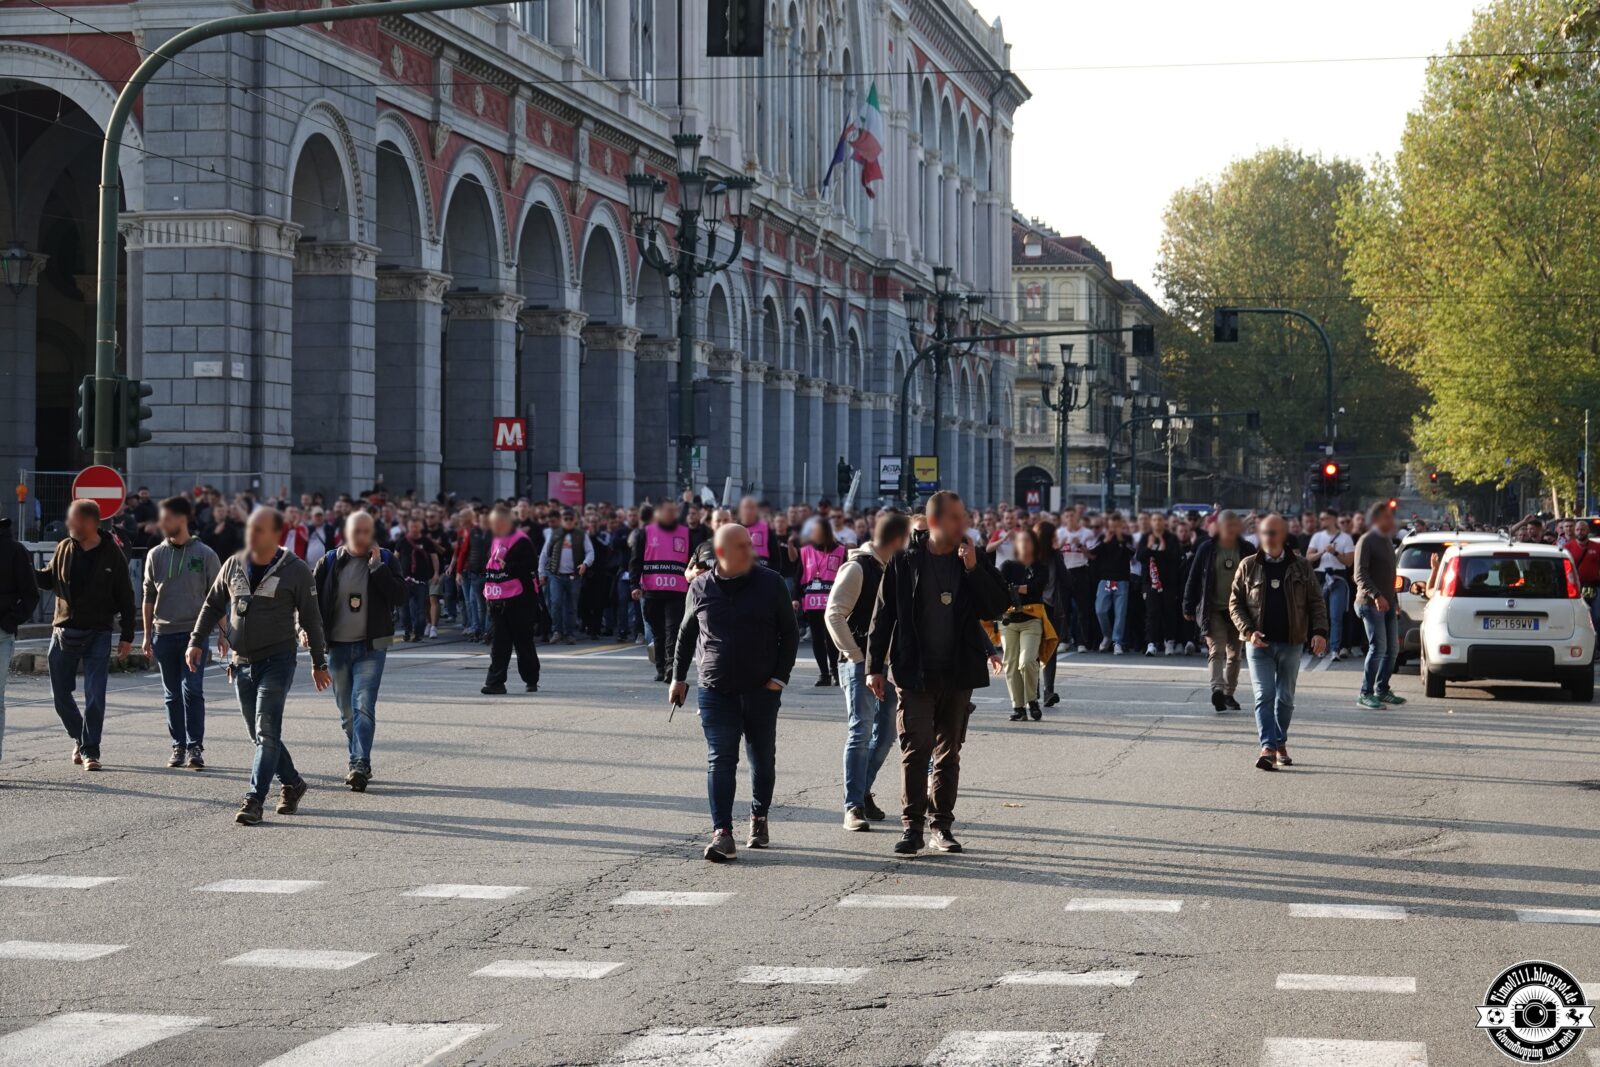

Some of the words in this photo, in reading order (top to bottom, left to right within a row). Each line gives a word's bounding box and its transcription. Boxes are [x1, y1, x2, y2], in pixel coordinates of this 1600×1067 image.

[496, 422, 523, 446] M
[1027, 492, 1040, 504] M
[655, 576, 677, 587] 010
